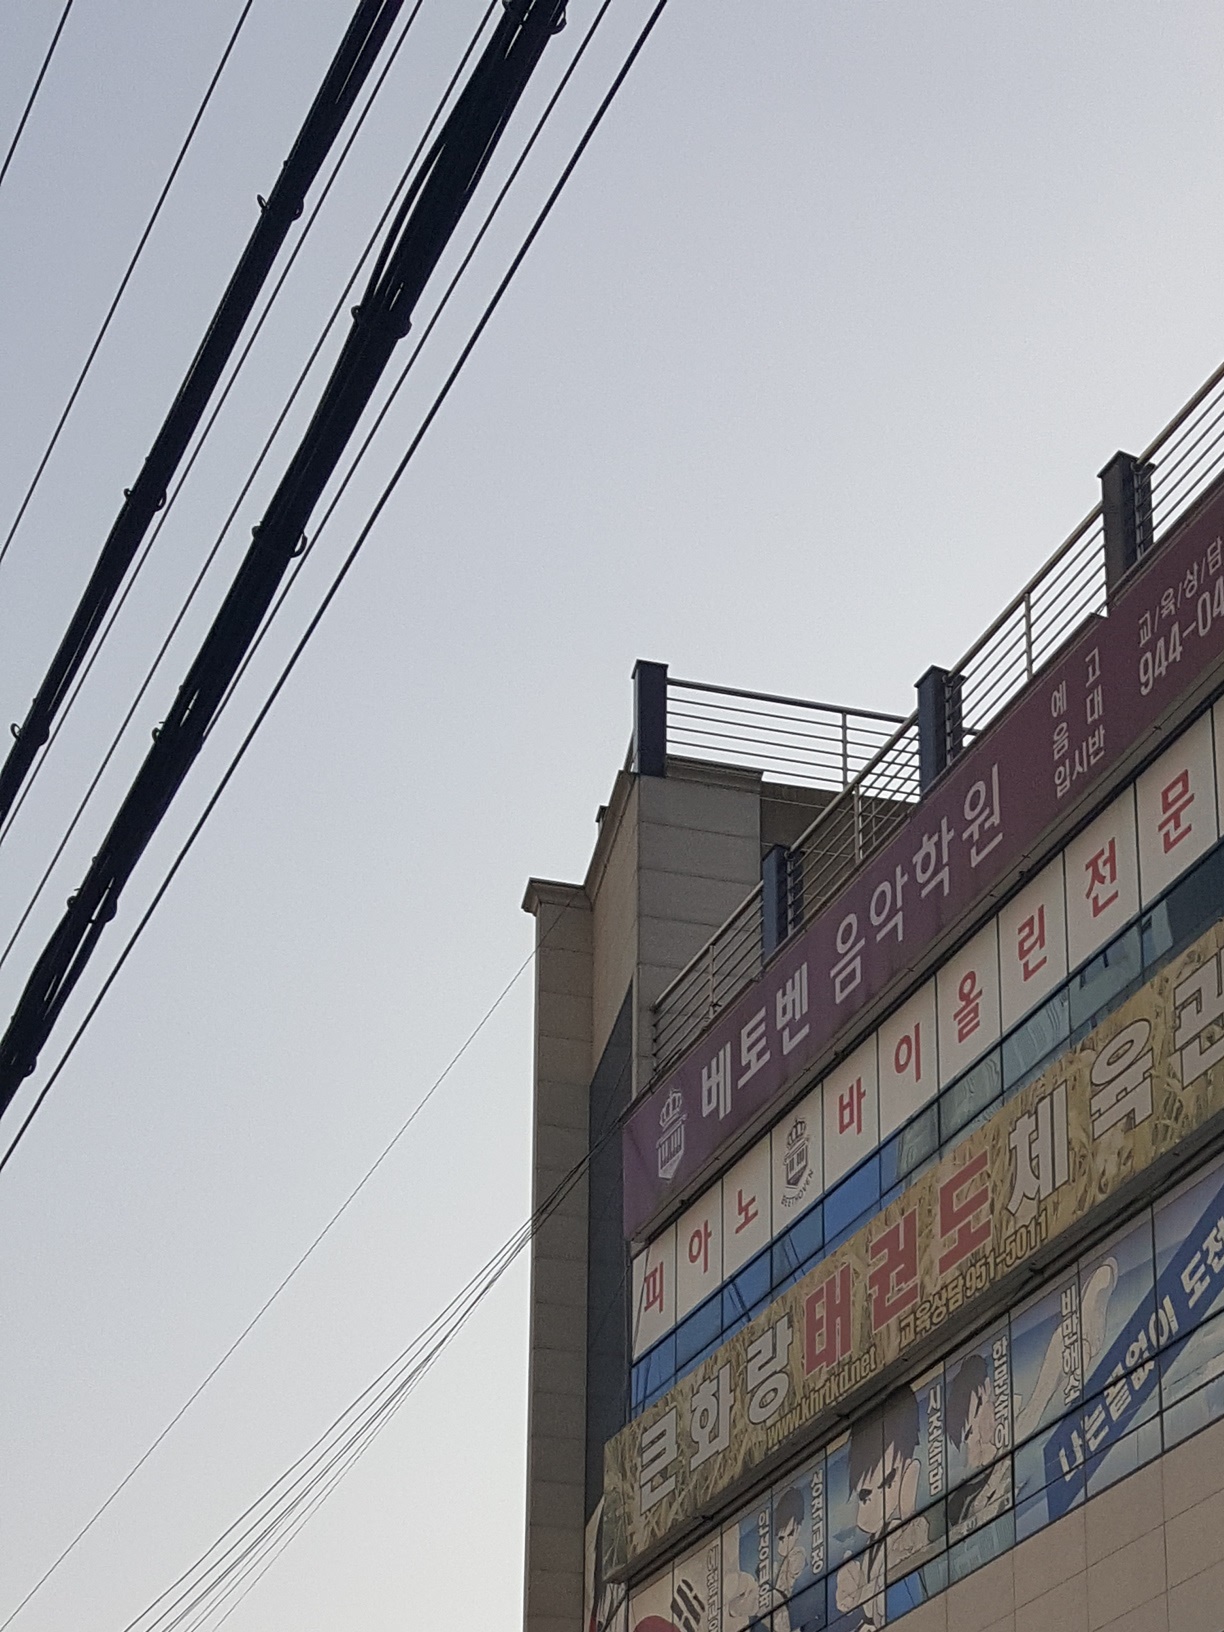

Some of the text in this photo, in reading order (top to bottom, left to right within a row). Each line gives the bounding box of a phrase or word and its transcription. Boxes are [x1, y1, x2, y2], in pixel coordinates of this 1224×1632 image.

[1139, 536, 1224, 648] 교/육/상/담
[1054, 724, 1105, 800] 입시반
[701, 764, 1004, 1120] 베토벤 음악학원
[644, 1189, 758, 1314] 피아노
[900, 1213, 1050, 1350] 교육상담 951-5011
[640, 1312, 794, 1514] 큰화랑
[805, 1148, 993, 1375] 태권도
[1060, 1285, 1082, 1405] 비만해소
[755, 1508, 773, 1610] 인성교육
